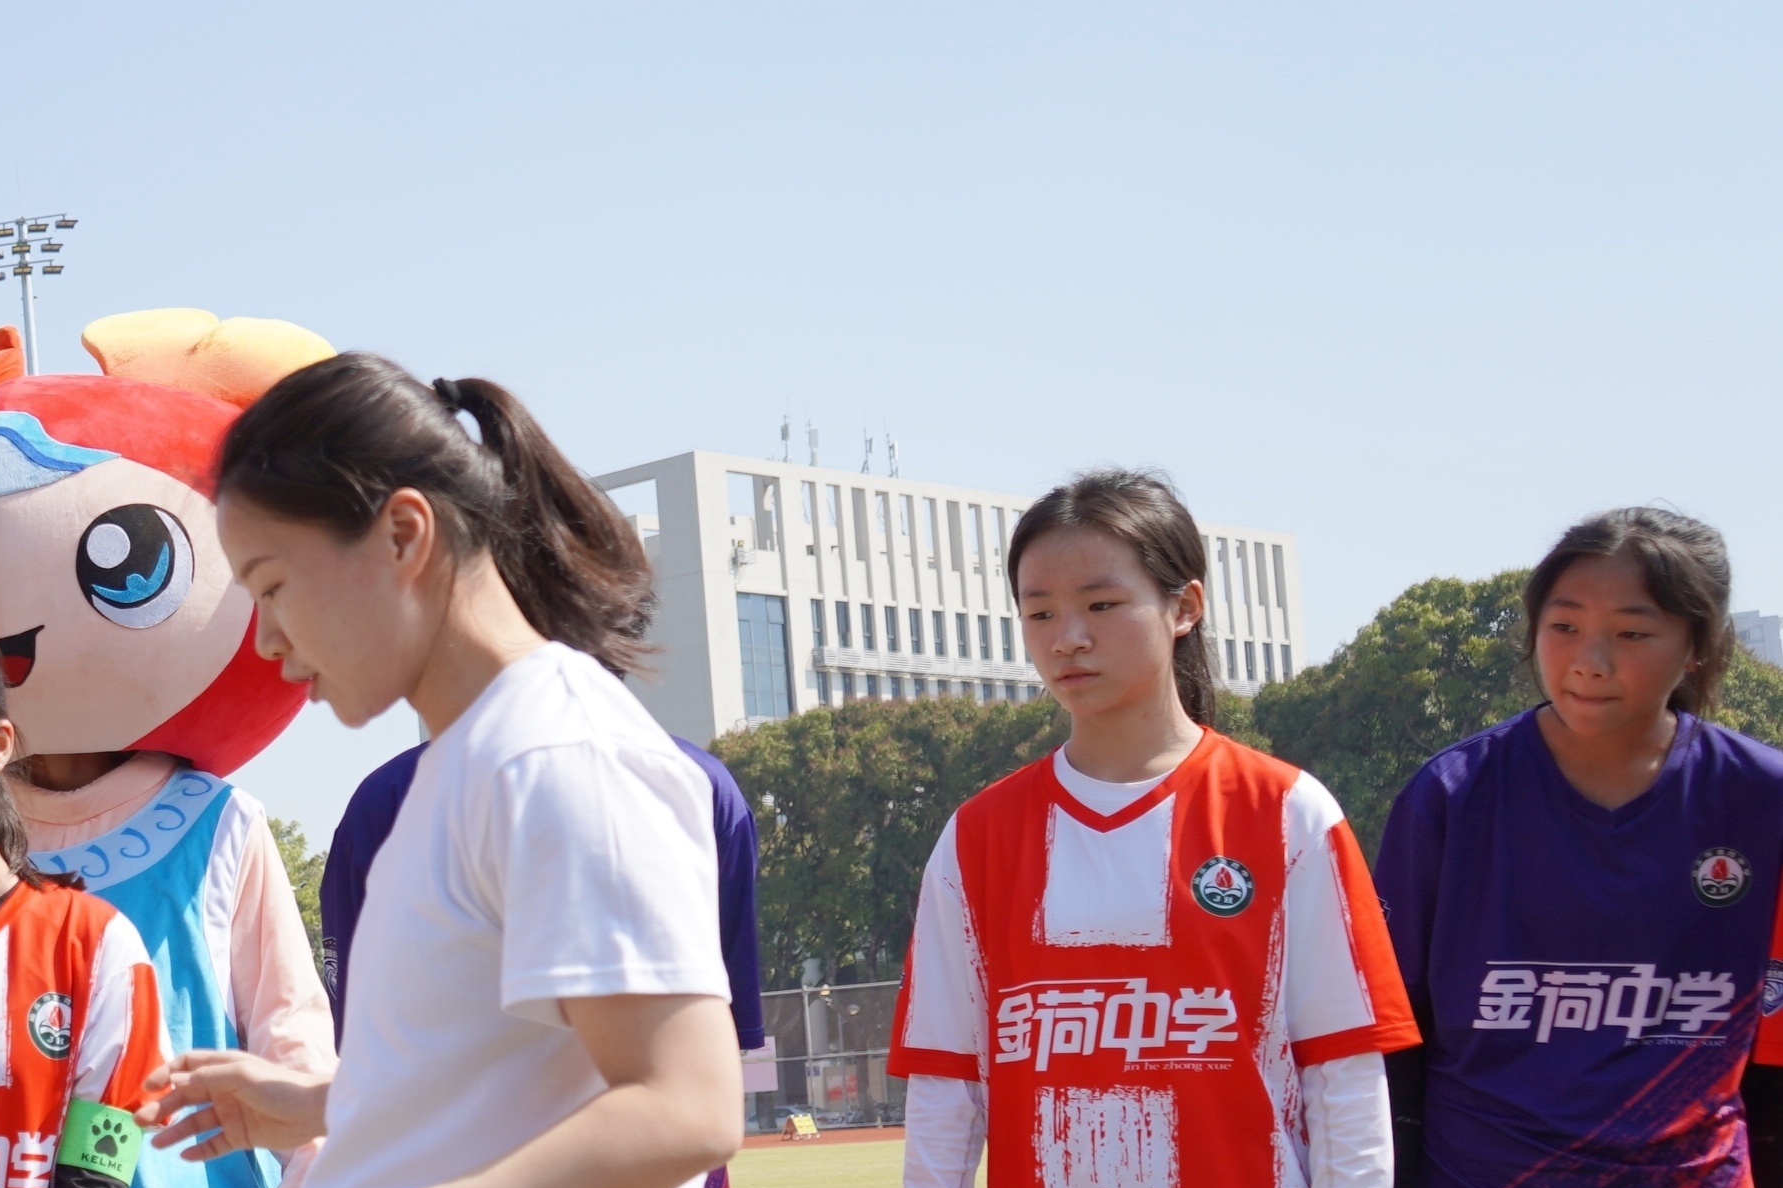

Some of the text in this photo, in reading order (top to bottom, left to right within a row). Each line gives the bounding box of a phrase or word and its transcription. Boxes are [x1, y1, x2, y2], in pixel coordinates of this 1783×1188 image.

[995, 978, 1238, 1072] 金荷中学
[1472, 961, 1736, 1044] 金荷中学
[1162, 1061, 1203, 1072] zhong
[81, 1152, 123, 1172] KELME
